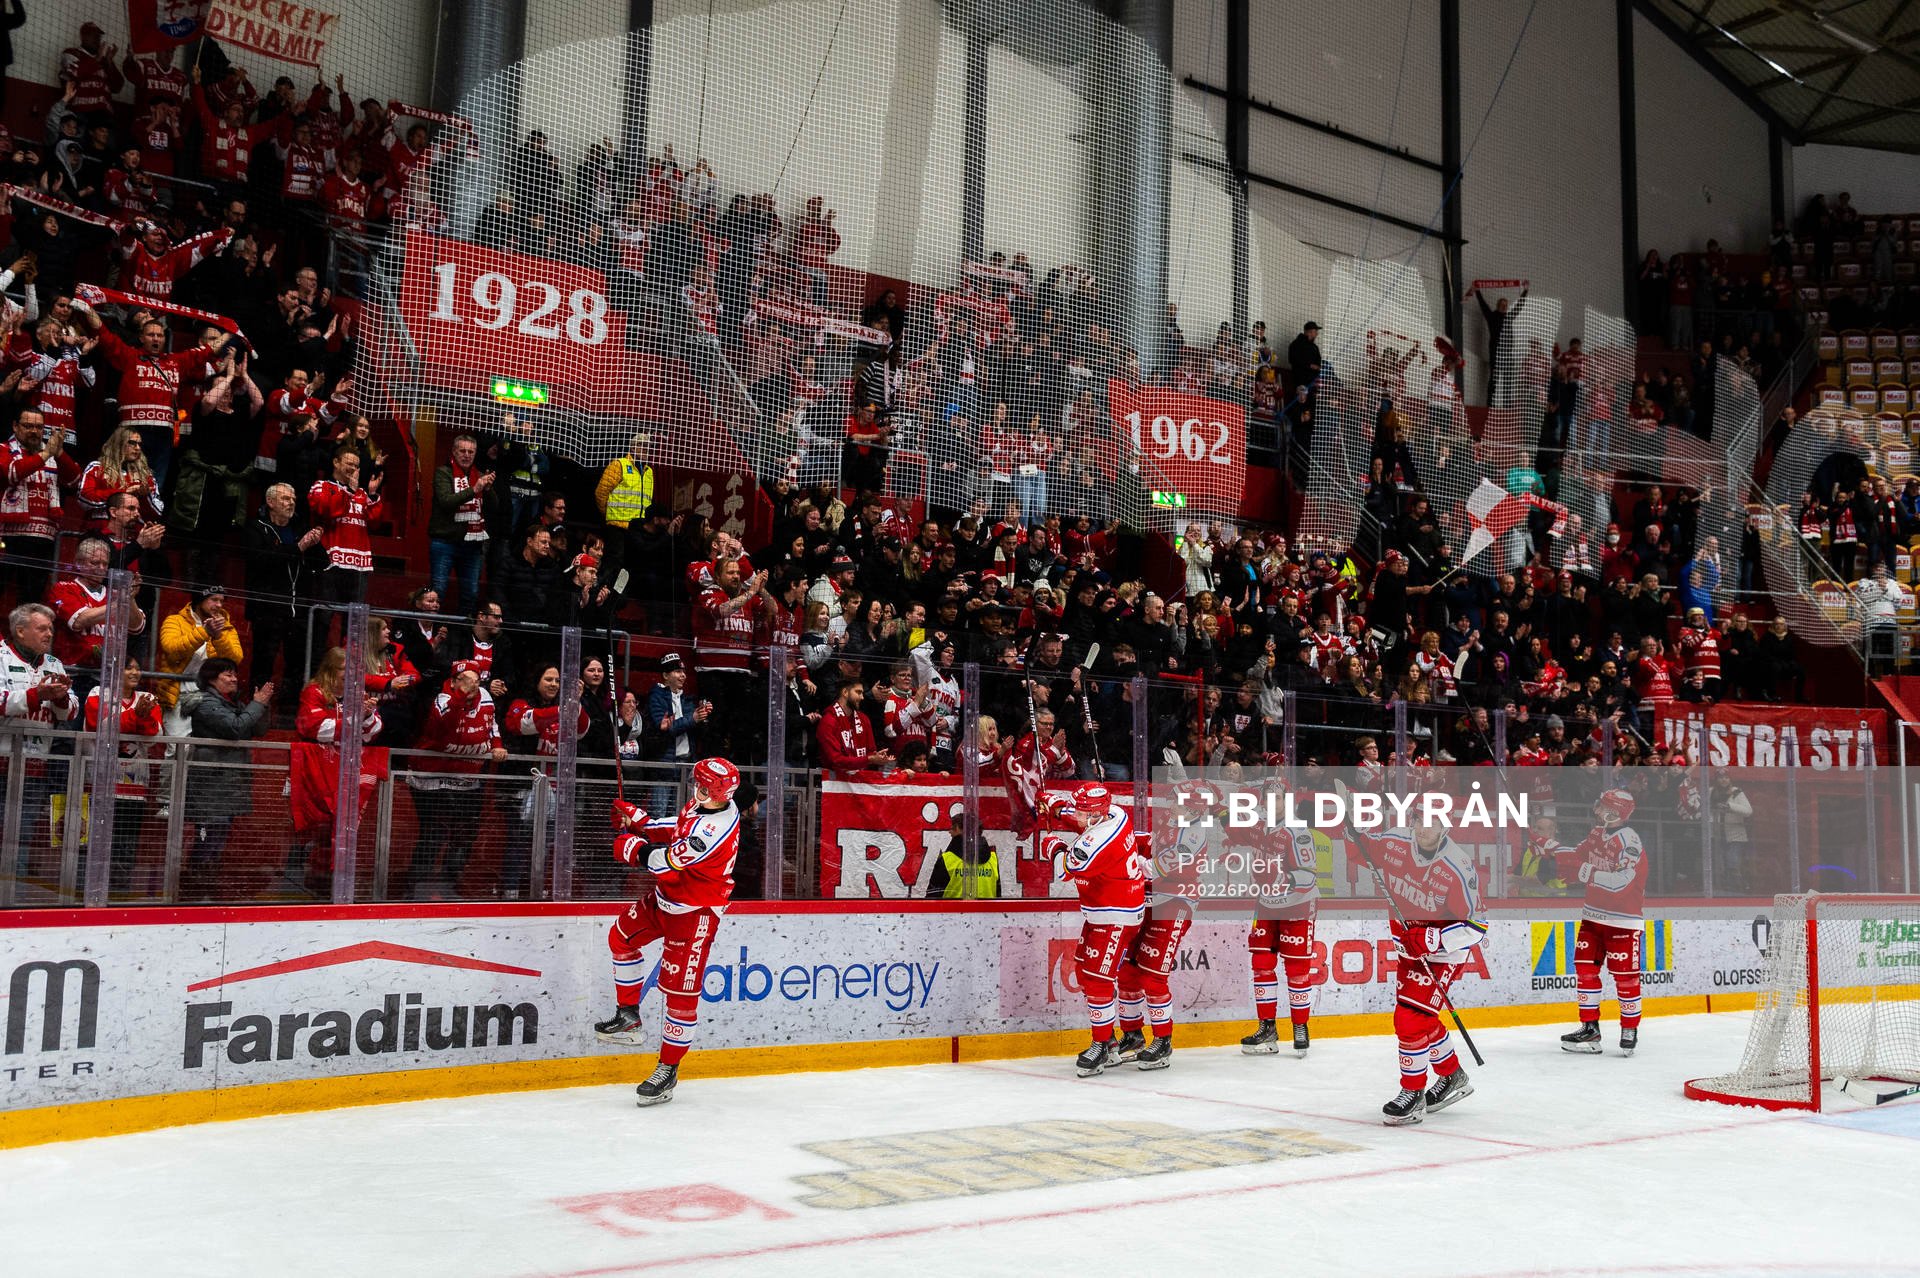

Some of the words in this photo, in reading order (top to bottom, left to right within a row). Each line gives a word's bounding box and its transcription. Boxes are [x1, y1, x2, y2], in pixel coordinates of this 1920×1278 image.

[206, 7, 325, 61] DYNAMIT
[219, 0, 334, 34] OCKEY
[429, 262, 609, 346] 1928
[1124, 411, 1232, 465] 1962
[1664, 711, 1802, 768] VÄSTRA
[1810, 719, 1878, 772] STÅ
[672, 843, 696, 865] 94
[1387, 872, 1438, 913] TIMRÅ
[1531, 976, 1577, 991] EUROCO
[182, 992, 538, 1070] Faradium
[3, 1060, 96, 1083] TER
